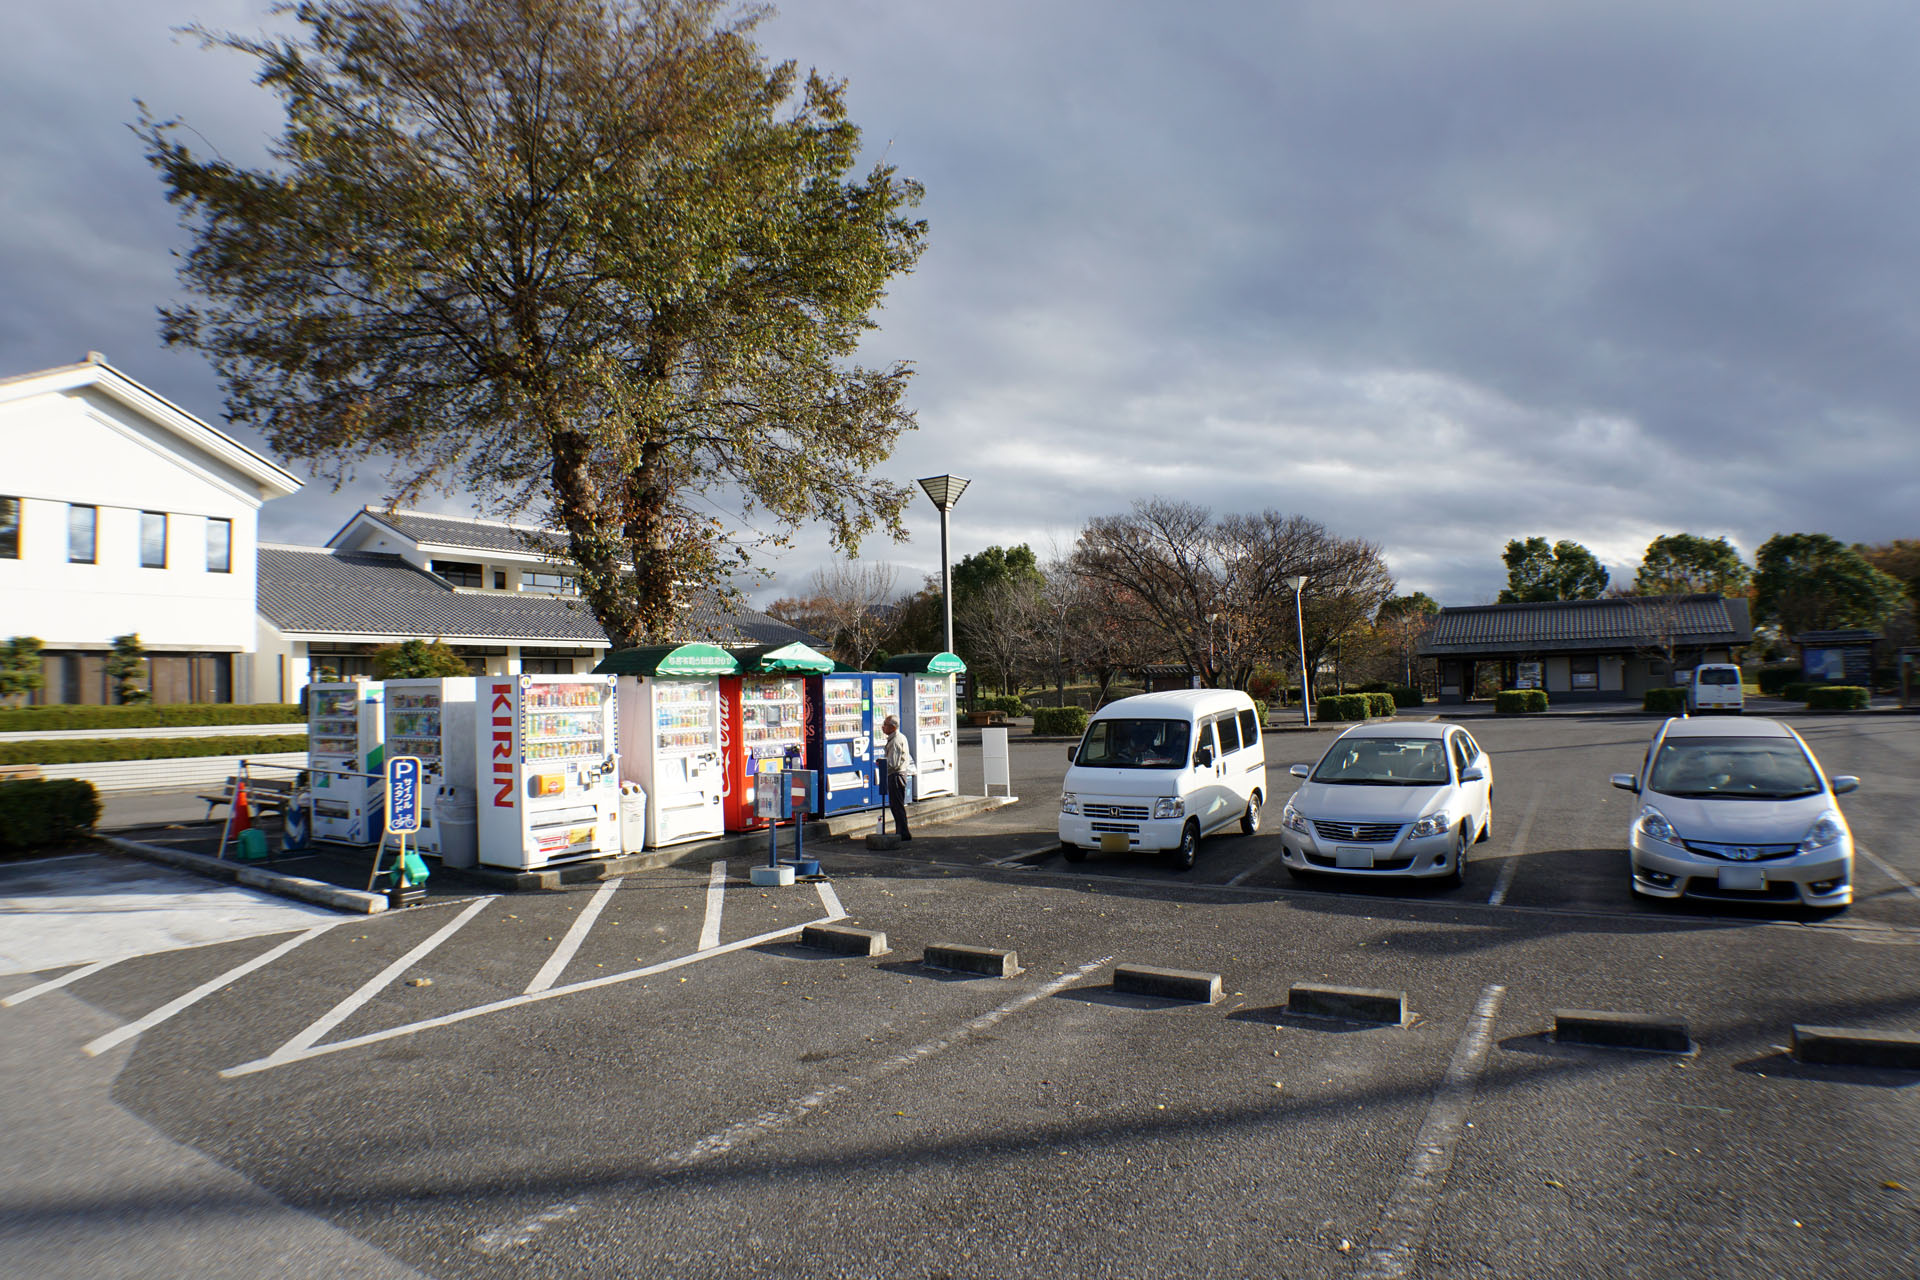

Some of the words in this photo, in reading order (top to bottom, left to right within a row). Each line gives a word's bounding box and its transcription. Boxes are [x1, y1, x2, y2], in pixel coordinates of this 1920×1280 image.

[492, 684, 514, 807] KIRIN
[395, 762, 413, 779] P
[394, 782, 404, 813] スタンド
[403, 778, 413, 809] サイクル
